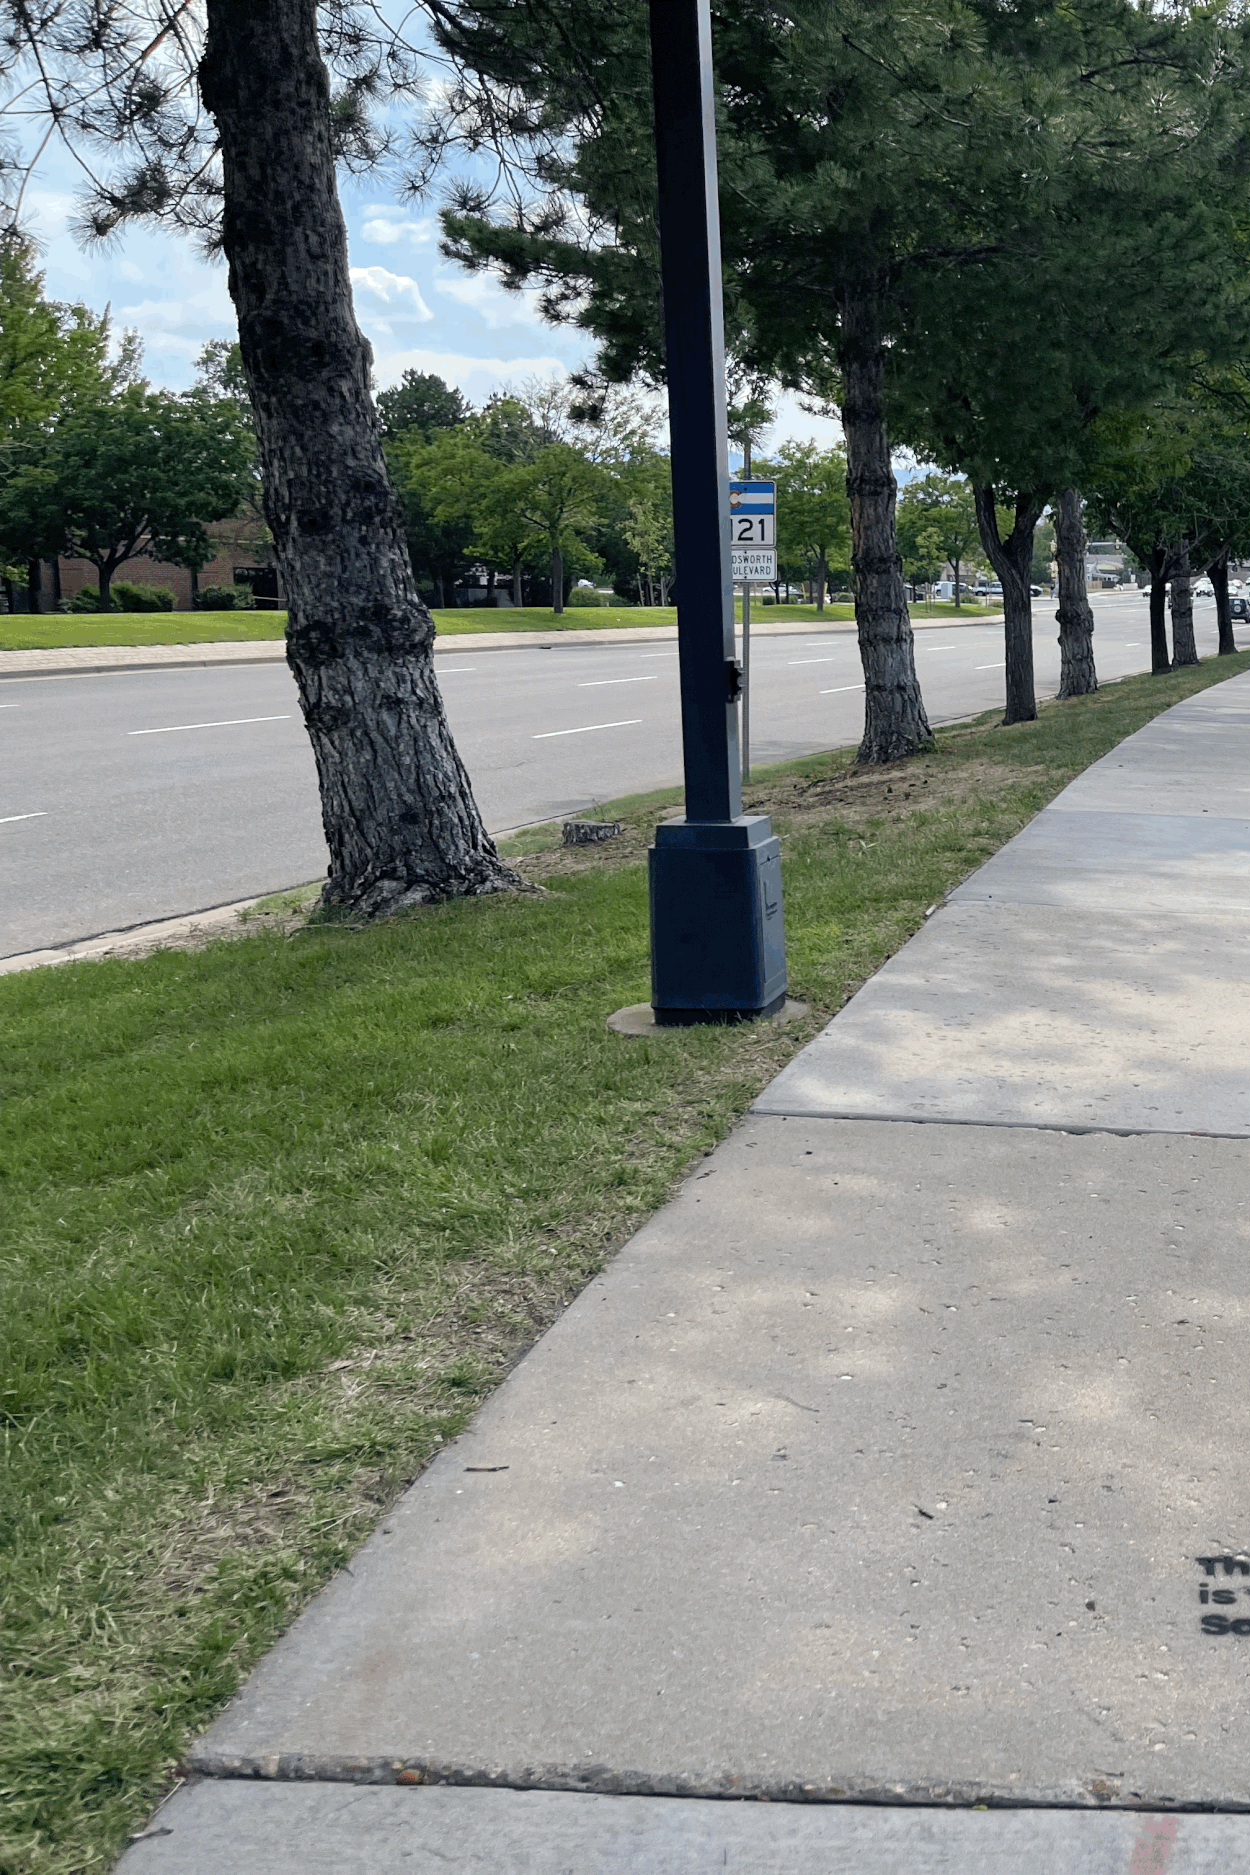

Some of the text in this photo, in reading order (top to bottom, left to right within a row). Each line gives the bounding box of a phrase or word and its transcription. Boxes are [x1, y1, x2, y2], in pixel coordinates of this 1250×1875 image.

[732, 555, 772, 564] DSWORTH
[733, 566, 771, 575] ULEVARD
[1199, 1583, 1238, 1605] is
